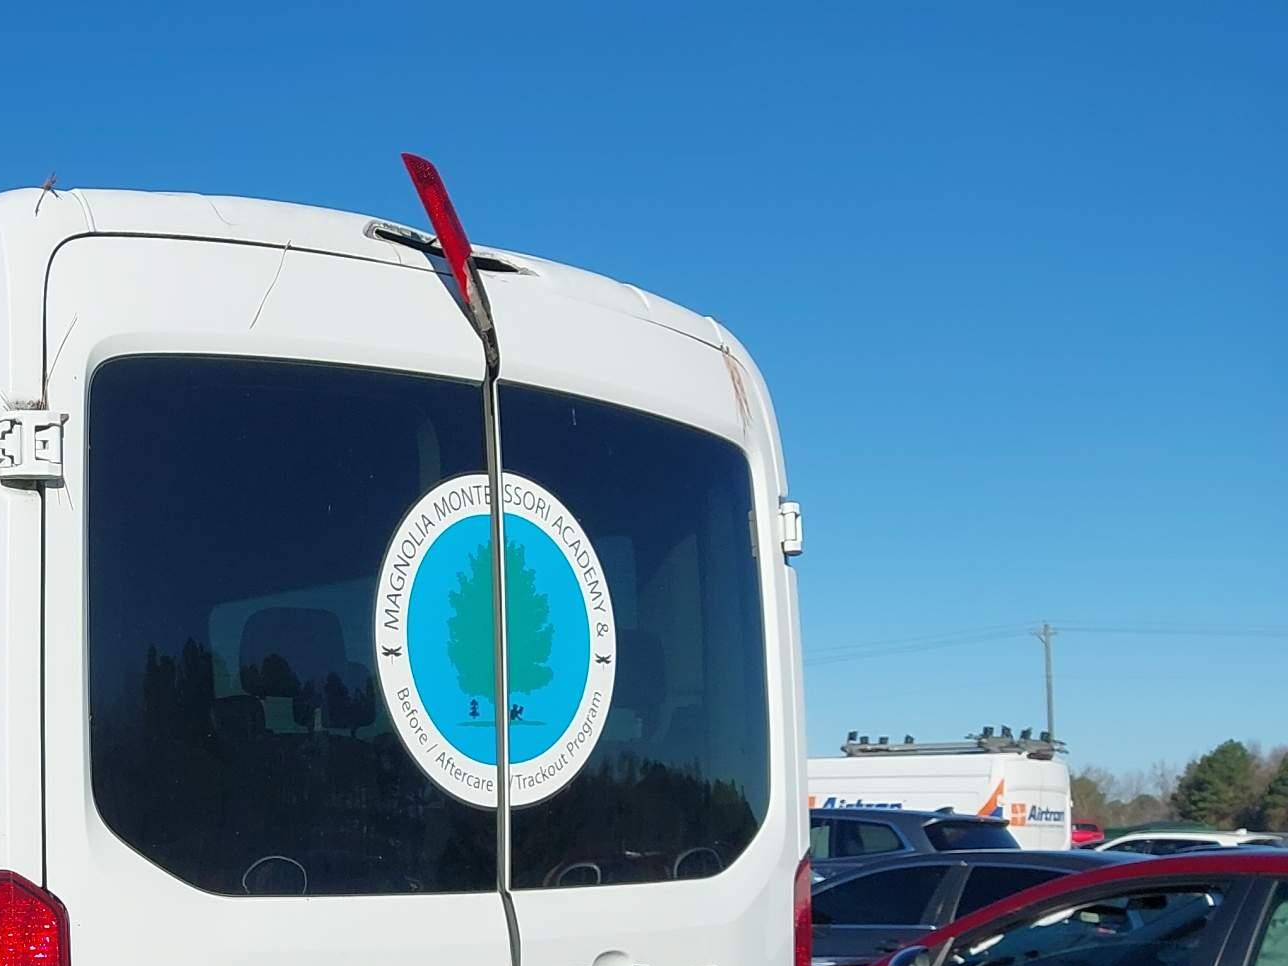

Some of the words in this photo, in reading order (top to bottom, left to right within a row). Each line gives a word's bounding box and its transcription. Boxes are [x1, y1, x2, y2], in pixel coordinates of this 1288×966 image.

[384, 514, 435, 630] MAGNOLIA
[551, 516, 606, 613] ACADEMY
[596, 622, 609, 637] &
[397, 687, 428, 745] Before
[426, 743, 439, 753] /
[435, 751, 494, 792] Aftercare
[566, 691, 603, 757] Program
